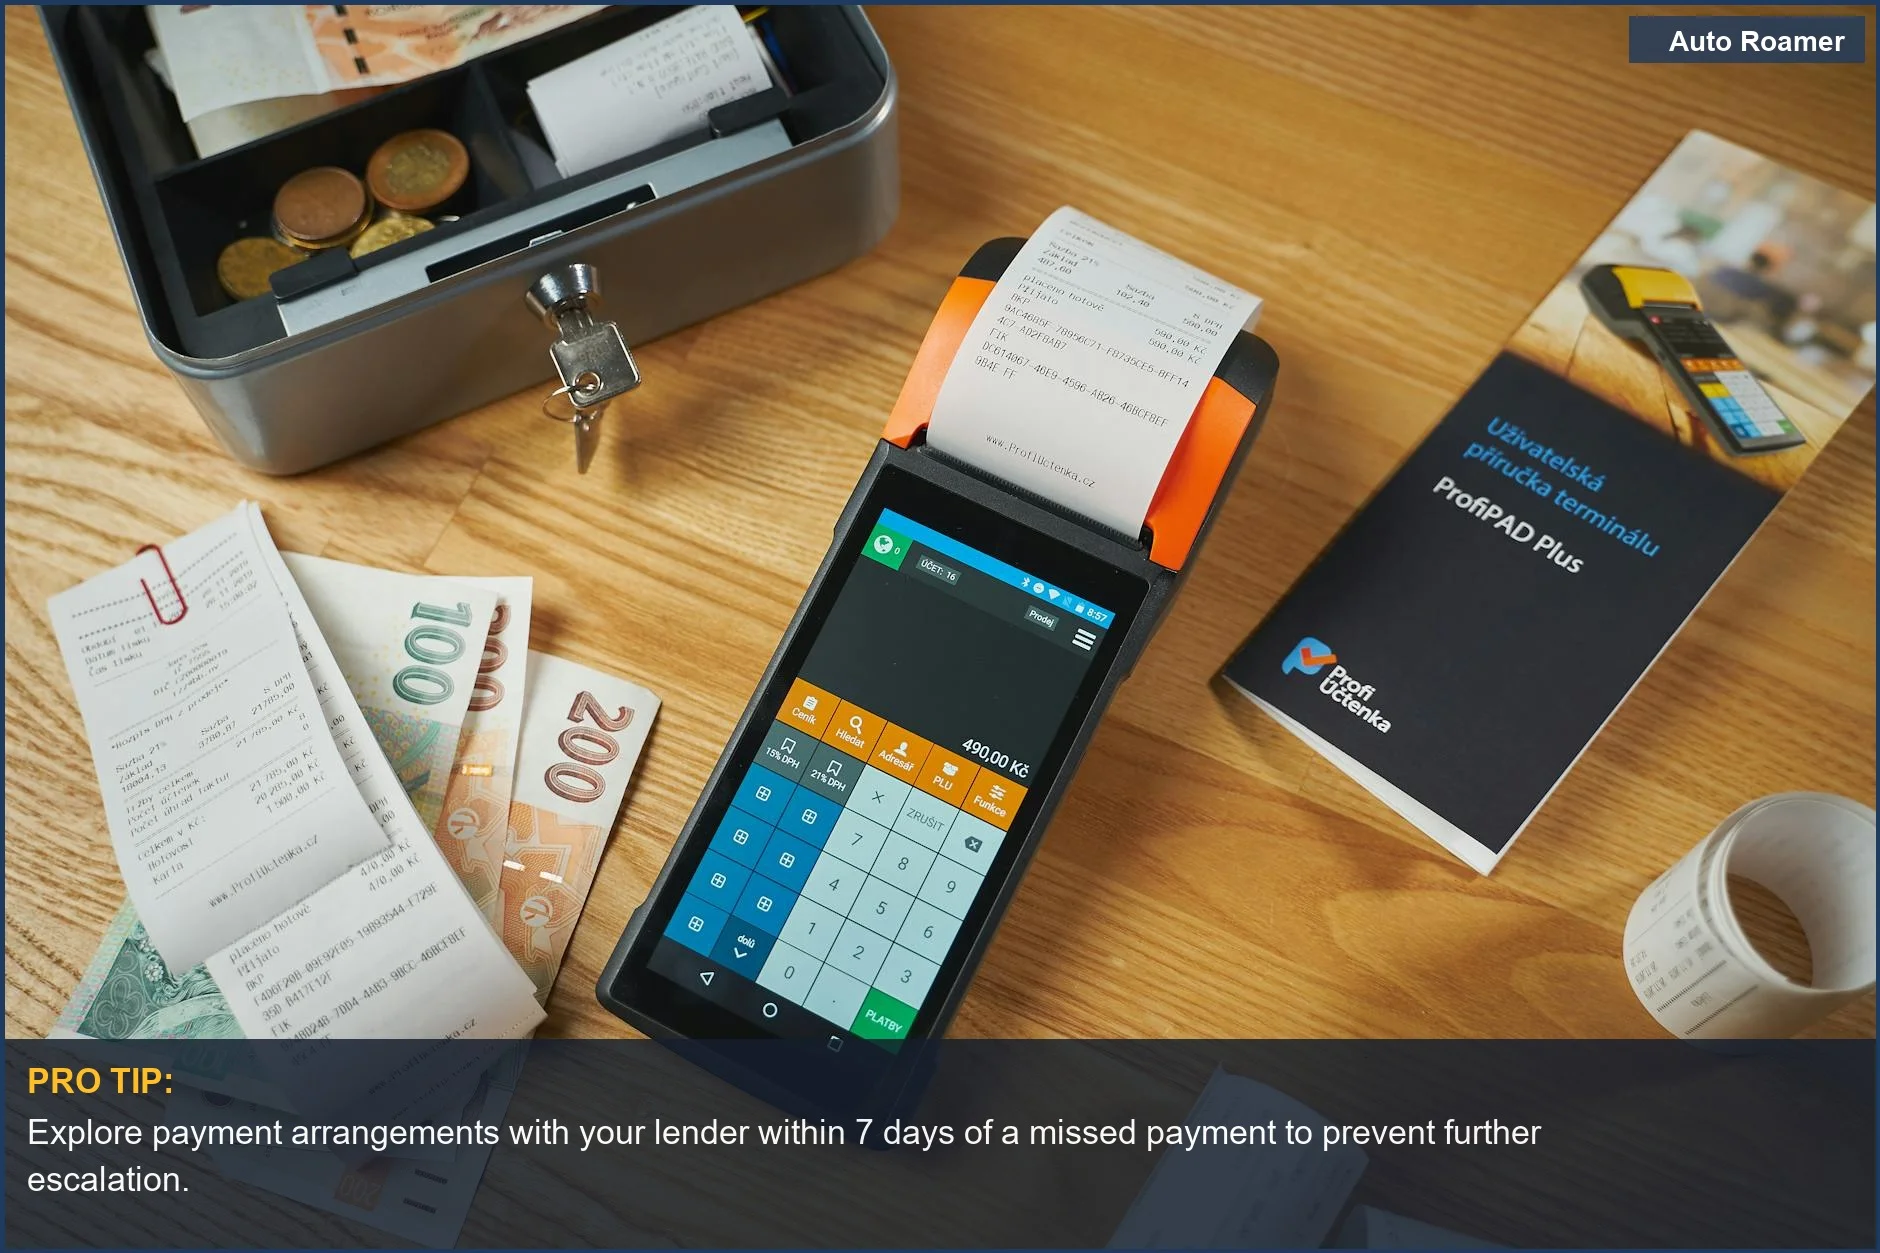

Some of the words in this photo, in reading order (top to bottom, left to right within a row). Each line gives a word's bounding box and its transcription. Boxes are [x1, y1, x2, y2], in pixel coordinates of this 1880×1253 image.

[1011, 293, 1030, 304] BKP
[1022, 275, 1065, 295] placeno
[1068, 293, 1104, 312] hotově
[1155, 328, 1190, 347] 590,00
[1193, 345, 1207, 355] Kč
[989, 328, 1008, 342] FIK
[1148, 338, 1184, 358] 590,00
[1187, 354, 1201, 364] Kč
[1487, 415, 1607, 493] Uživatelská
[1464, 443, 1552, 496] příručka
[1554, 490, 1659, 556] terminálu
[1432, 477, 1534, 543] ProfiPAD
[1533, 535, 1583, 573] Plus
[921, 559, 943, 575] ÚČET:
[947, 572, 956, 580] 16
[1029, 610, 1054, 627] Prodej
[1085, 606, 1109, 625] 8:57
[392, 601, 474, 706] 100
[317, 682, 330, 695] Kč
[1325, 661, 1378, 705] Profi
[1316, 673, 1393, 735] Účtenka
[343, 736, 357, 748] Kč
[544, 690, 636, 803] 200
[354, 758, 369, 772] Kč
[766, 747, 781, 760] 15%
[781, 755, 800, 768] DPH
[793, 708, 816, 724] Ceník
[835, 727, 865, 749] Hledat
[877, 746, 914, 771] Adresář
[930, 776, 952, 793] PLU
[971, 793, 1009, 820] Funkce
[962, 739, 1009, 768] 490,00
[1009, 760, 1029, 778] Kč
[158, 771, 194, 794] celkem
[811, 769, 827, 783] 21%
[827, 777, 846, 791] DPH
[906, 808, 944, 831] ZRUŠIT
[397, 838, 411, 852] Kč
[153, 862, 184, 885] Karta
[851, 832, 863, 846] 7
[897, 857, 909, 870] 8
[946, 880, 956, 893] 9
[229, 931, 271, 964] placeno
[273, 904, 309, 933] hotově
[406, 853, 419, 867] Kč
[829, 879, 840, 891] 4
[876, 901, 888, 915] 5
[923, 925, 934, 939] 6
[737, 935, 755, 948] dolů
[784, 966, 795, 979] 0
[808, 922, 816, 935] 1
[852, 945, 865, 960] 2
[900, 969, 912, 984] 3
[246, 974, 264, 991] BKP
[271, 1021, 292, 1037] FIK
[863, 1007, 904, 1033] PLATBY
